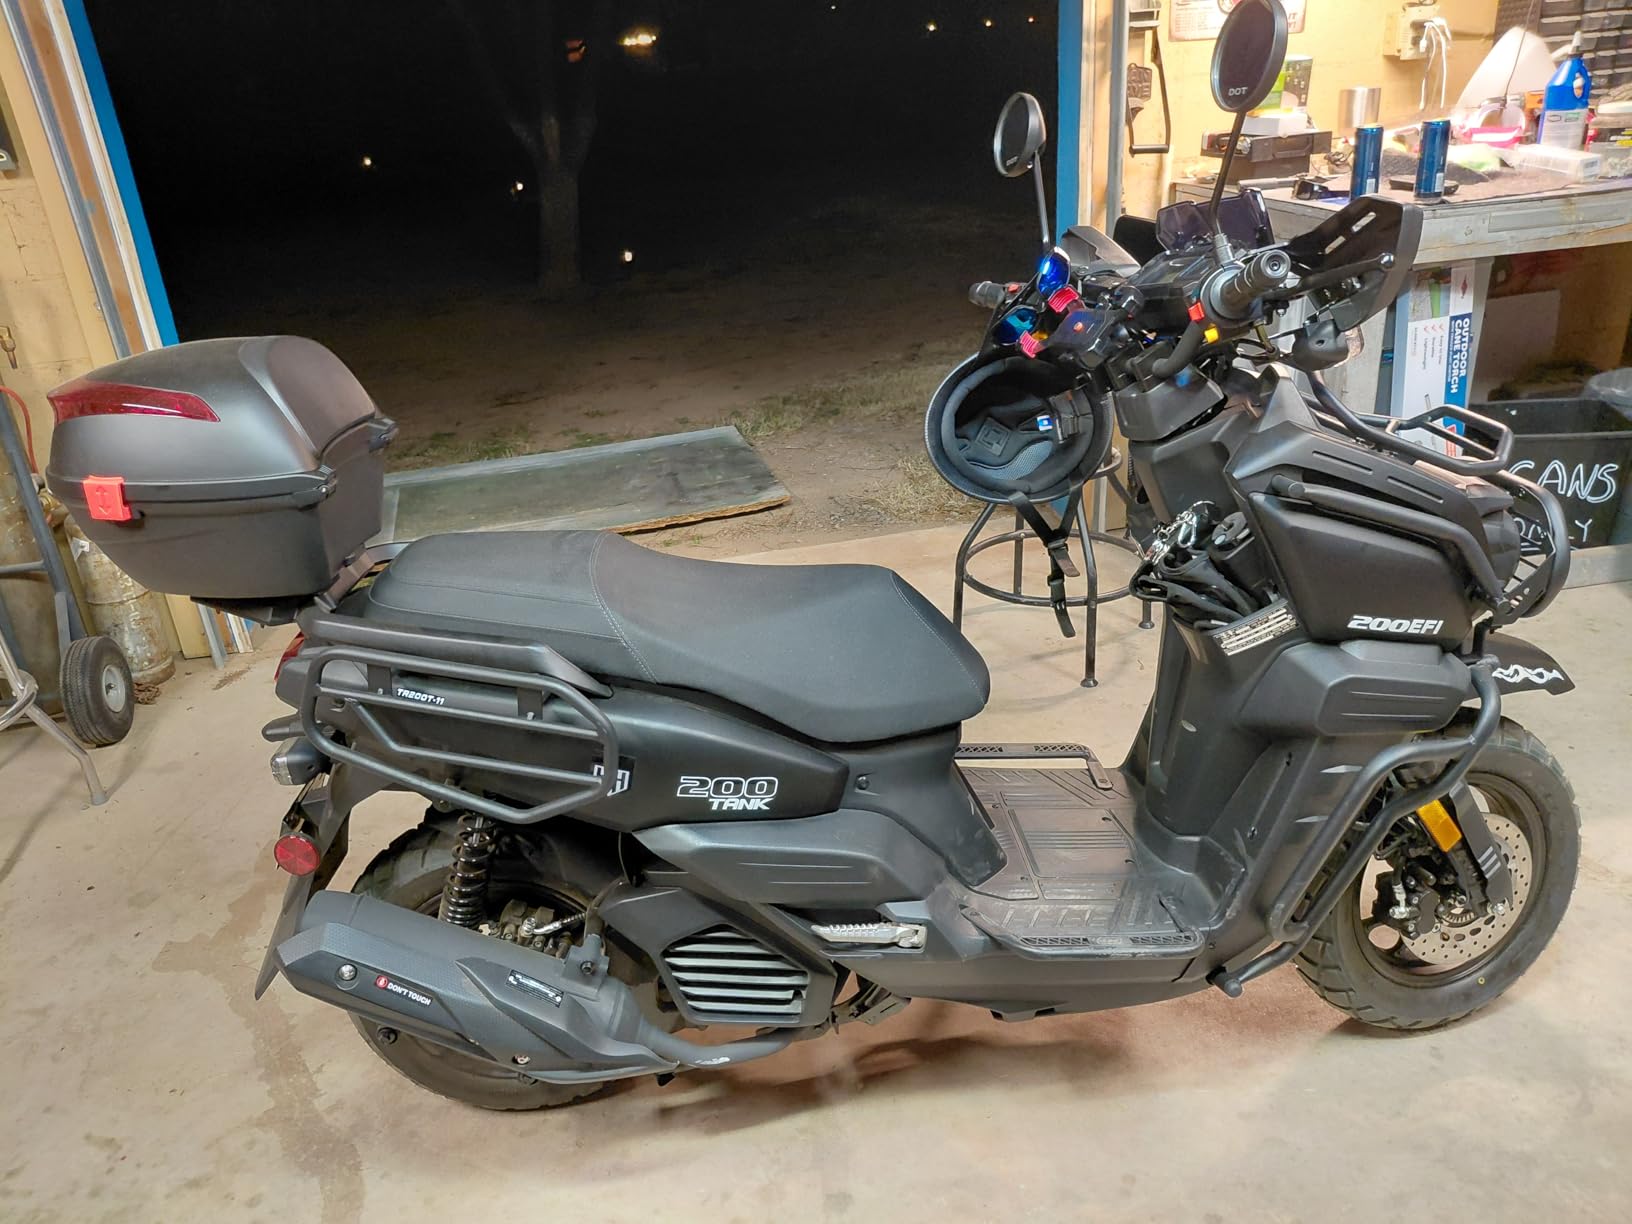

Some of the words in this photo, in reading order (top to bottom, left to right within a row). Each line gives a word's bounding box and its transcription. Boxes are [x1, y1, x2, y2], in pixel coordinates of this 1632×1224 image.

[1228, 86, 1248, 96] DOT
[1453, 319, 1463, 351] CANE
[1459, 318, 1470, 377] OUTDOOR
[1450, 352, 1461, 393] TORCH
[1347, 614, 1444, 635] 200EFI
[677, 776, 779, 798] 200
[708, 798, 775, 811] TANK
[408, 990, 432, 1006] TOUCH
